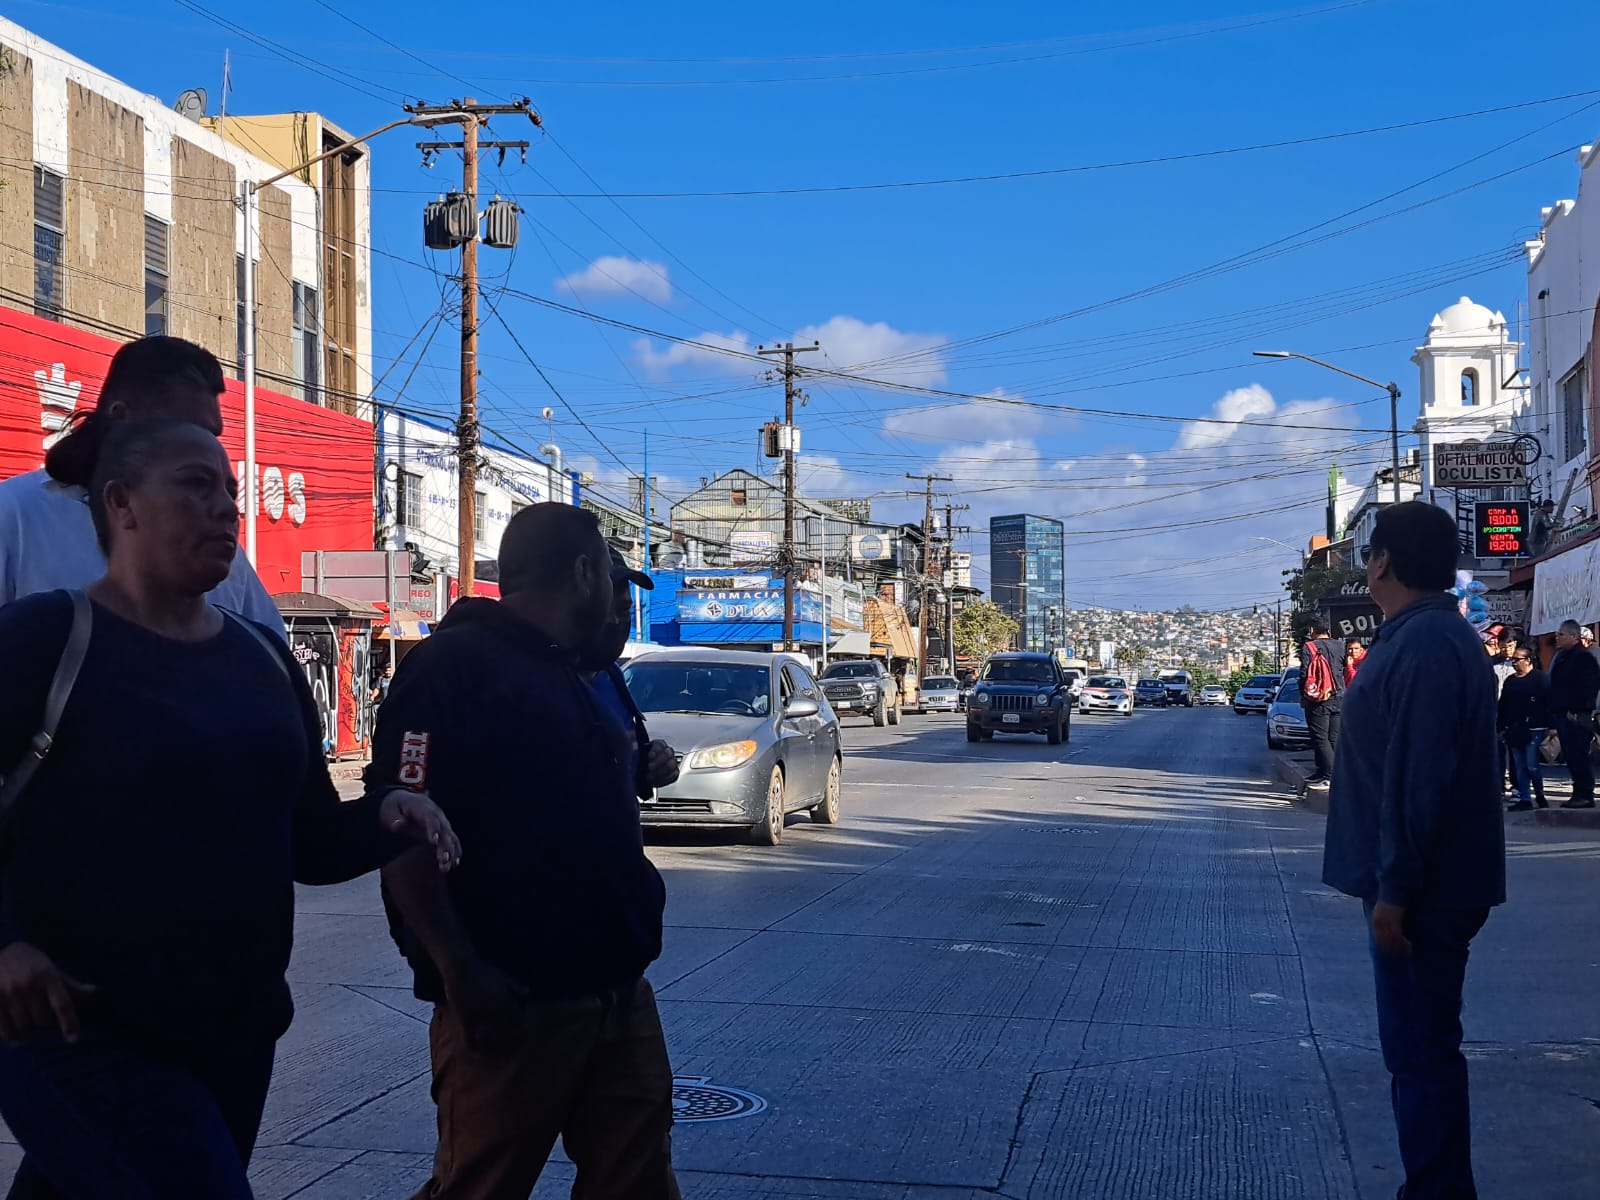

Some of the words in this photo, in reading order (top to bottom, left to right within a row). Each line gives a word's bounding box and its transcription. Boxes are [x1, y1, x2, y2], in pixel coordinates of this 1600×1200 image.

[1450, 443, 1480, 452] ENRIQUE
[1438, 467, 1523, 480] OCULISTA
[698, 591, 780, 600] FARMACIA
